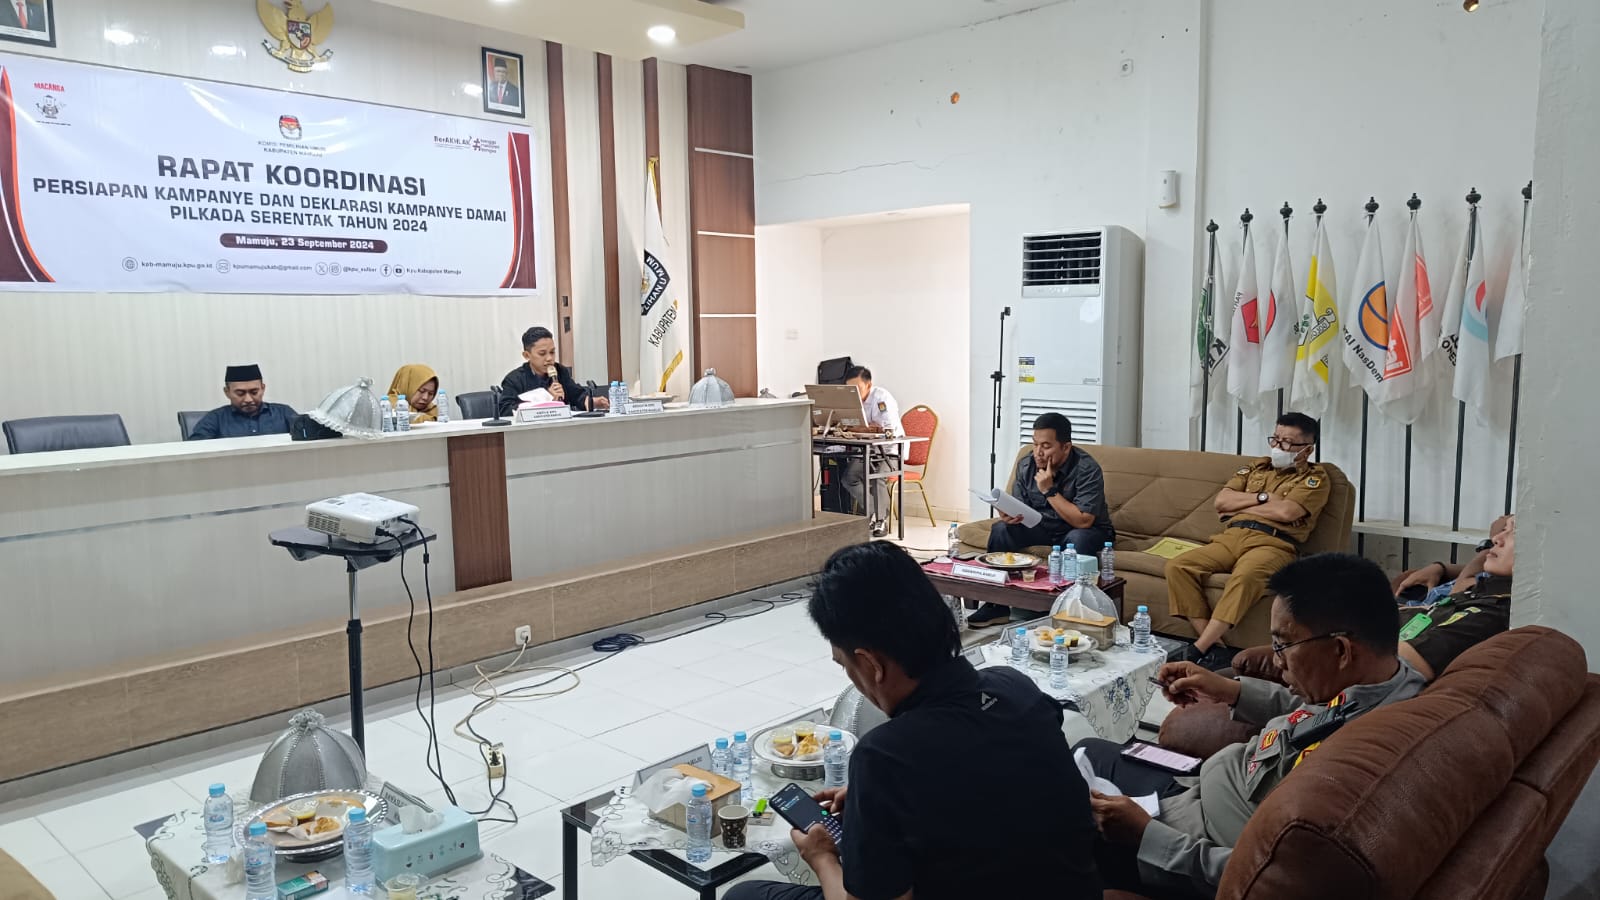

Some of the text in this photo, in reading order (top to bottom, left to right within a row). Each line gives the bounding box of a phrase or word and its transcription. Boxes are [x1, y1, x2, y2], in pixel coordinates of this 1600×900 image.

[157, 154, 427, 197] RAPAT KOORDINASI
[33, 177, 507, 223] PERSIAPAN KAMPANYE DAN DEKLARASI KAMPANYE DAMAI
[170, 205, 428, 233] PILKADA SERENTAK TAHUN 2024
[235, 236, 375, 250] Mamuju, 23 September 2024
[647, 305, 678, 347] KABUPATEN
[1352, 344, 1385, 384] NasDem
